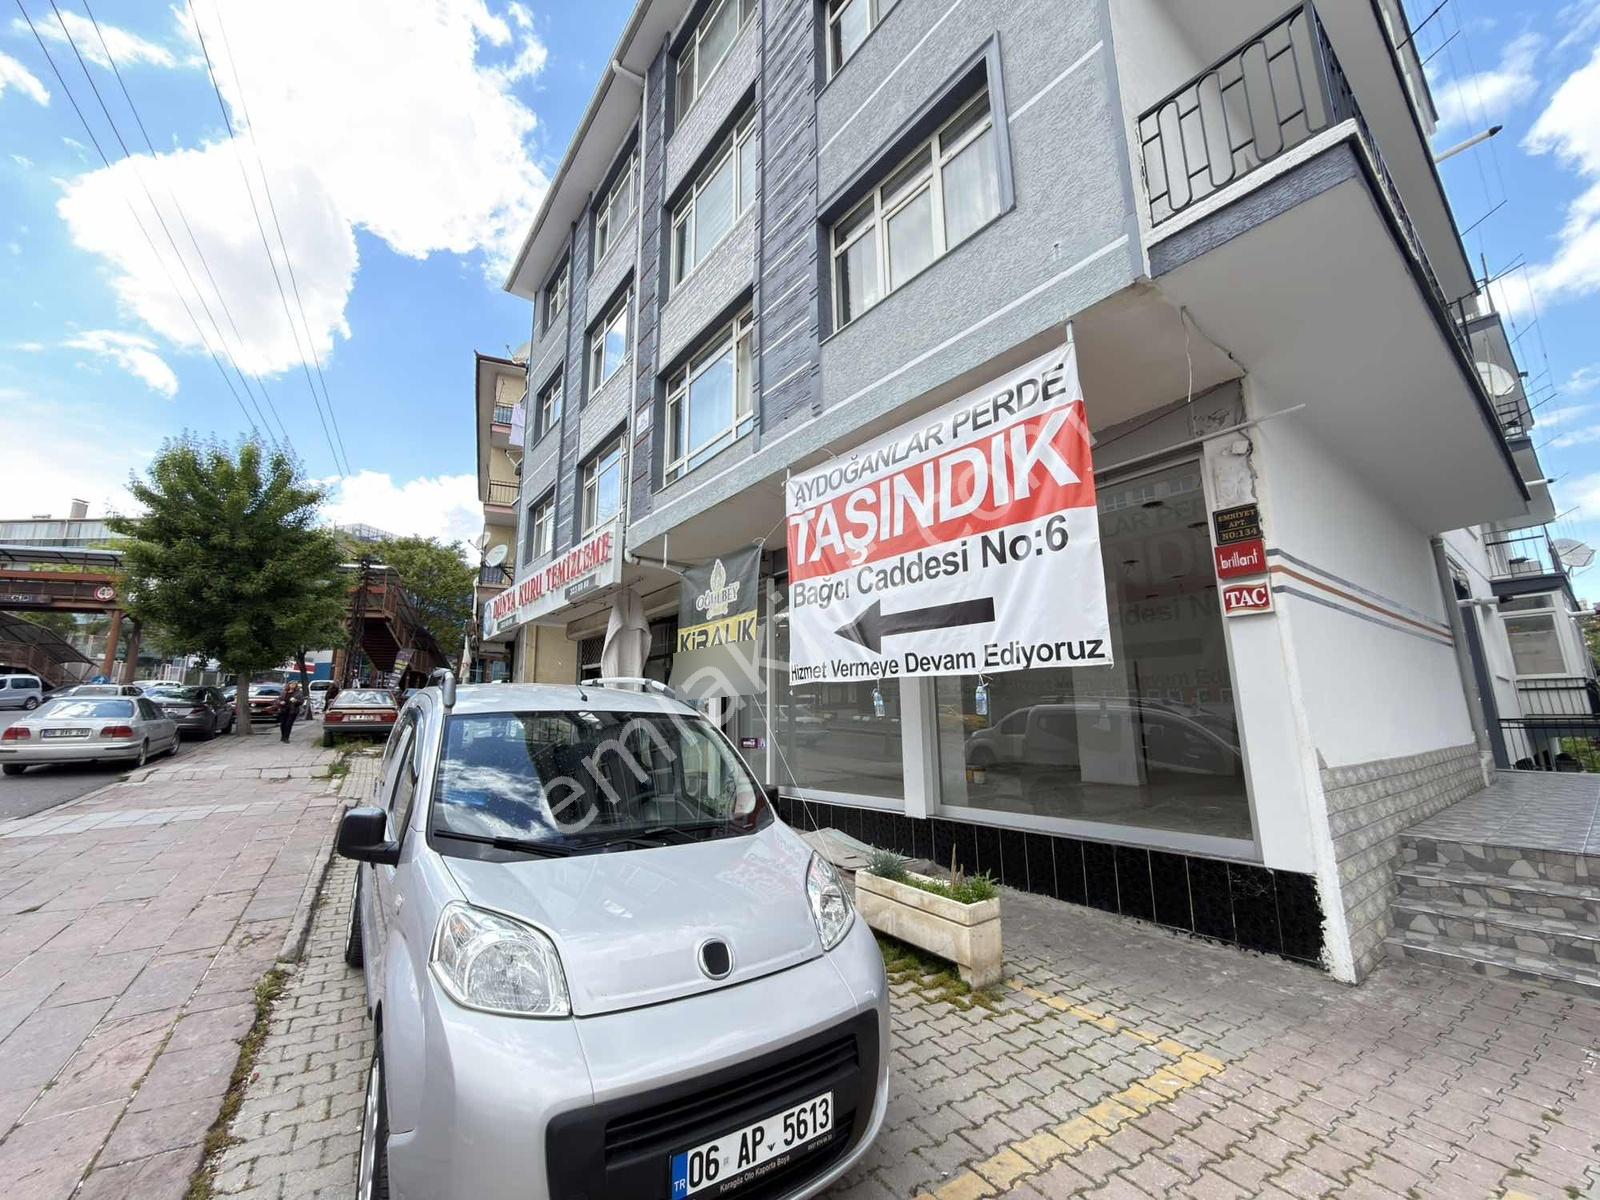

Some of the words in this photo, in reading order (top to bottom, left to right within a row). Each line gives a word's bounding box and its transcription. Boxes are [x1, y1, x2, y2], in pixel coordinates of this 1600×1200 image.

[794, 421, 944, 508] AYDOĞANLAR
[951, 363, 1067, 440] PERDE
[789, 408, 1083, 567] TAŞINDIK
[519, 573, 546, 607] KURU
[546, 530, 611, 592] TEMİZLEME
[792, 576, 850, 610] Bağcı
[856, 540, 969, 596] Caddesi
[980, 514, 1070, 569] No:6
[1219, 547, 1258, 570] brillant
[790, 661, 828, 683] Hizmet
[831, 656, 900, 679] Vermeye
[904, 651, 977, 673] Devam
[983, 637, 1106, 669] Ediyoruz
[688, 1144, 720, 1188] 06
[737, 1125, 766, 1169] AP
[783, 1097, 830, 1147] 5613
[674, 1178, 687, 1192] TR
